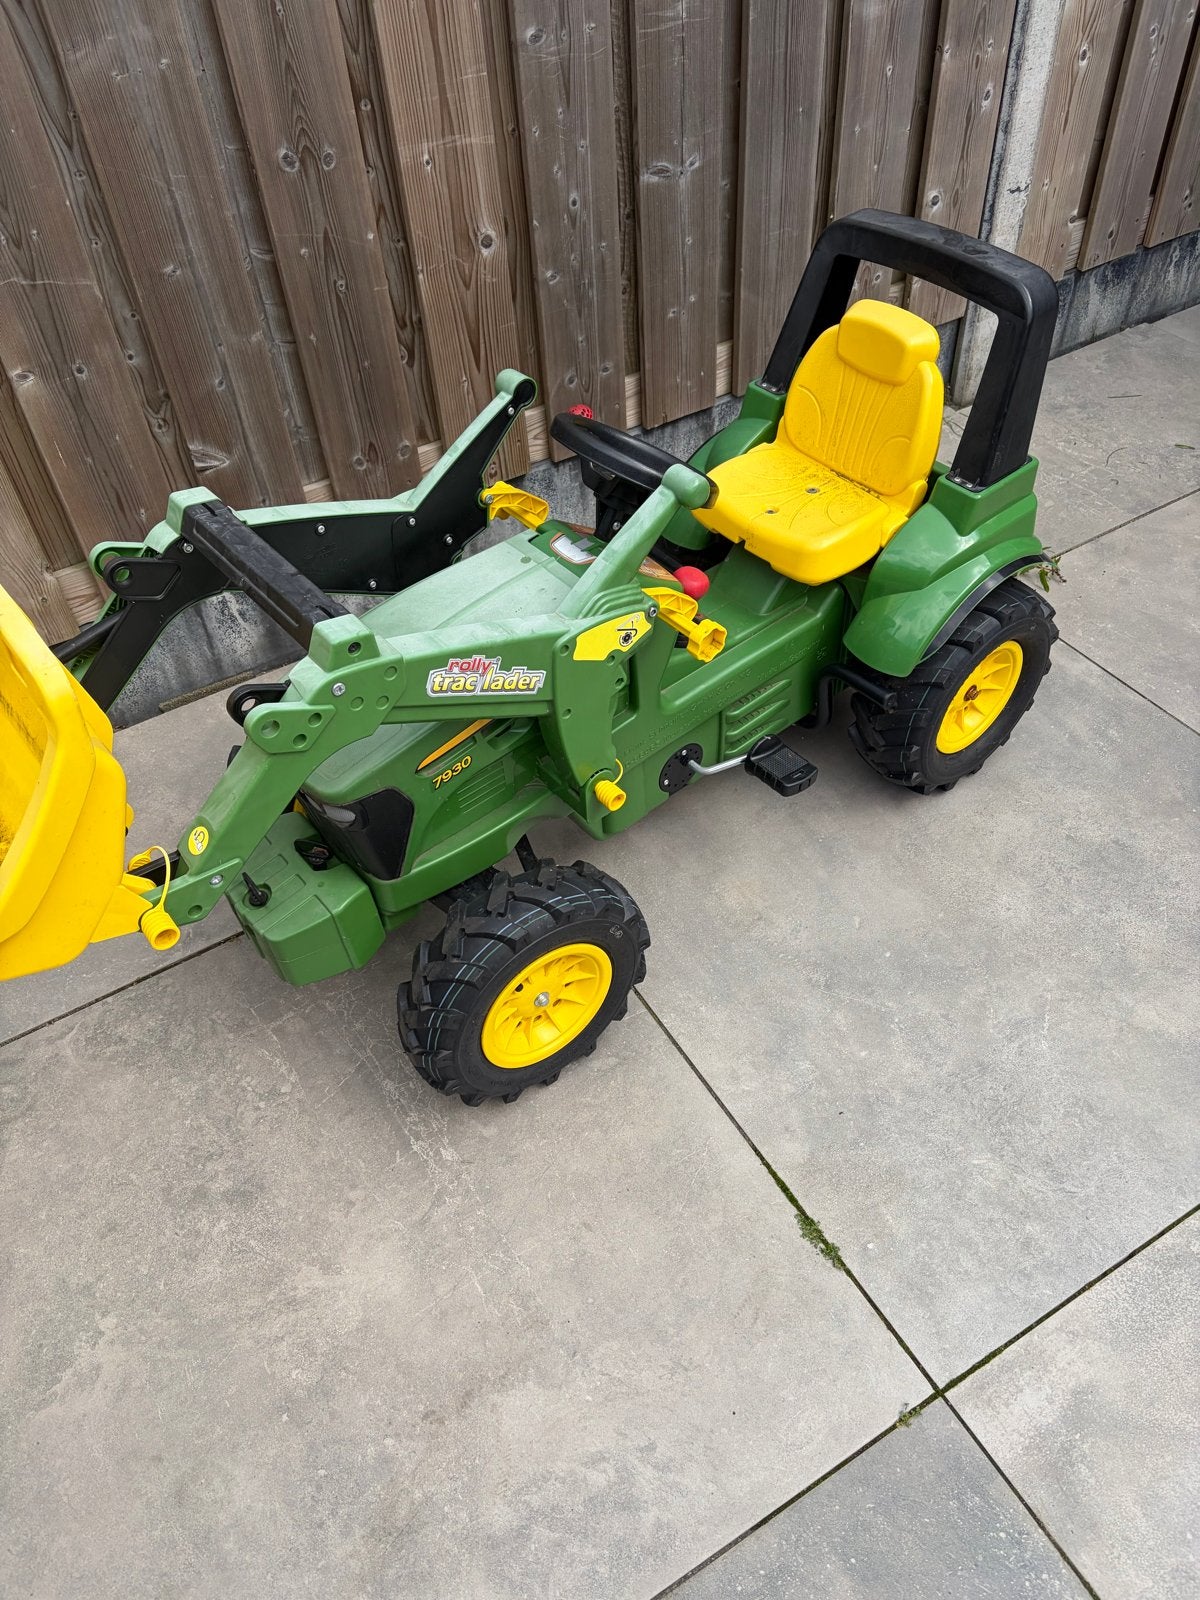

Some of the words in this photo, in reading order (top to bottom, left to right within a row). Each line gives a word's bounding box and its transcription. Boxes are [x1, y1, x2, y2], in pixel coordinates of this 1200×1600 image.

[431, 673, 478, 692] trac
[482, 667, 542, 691] lader
[447, 657, 493, 677] rolly
[432, 755, 473, 791] 7930
